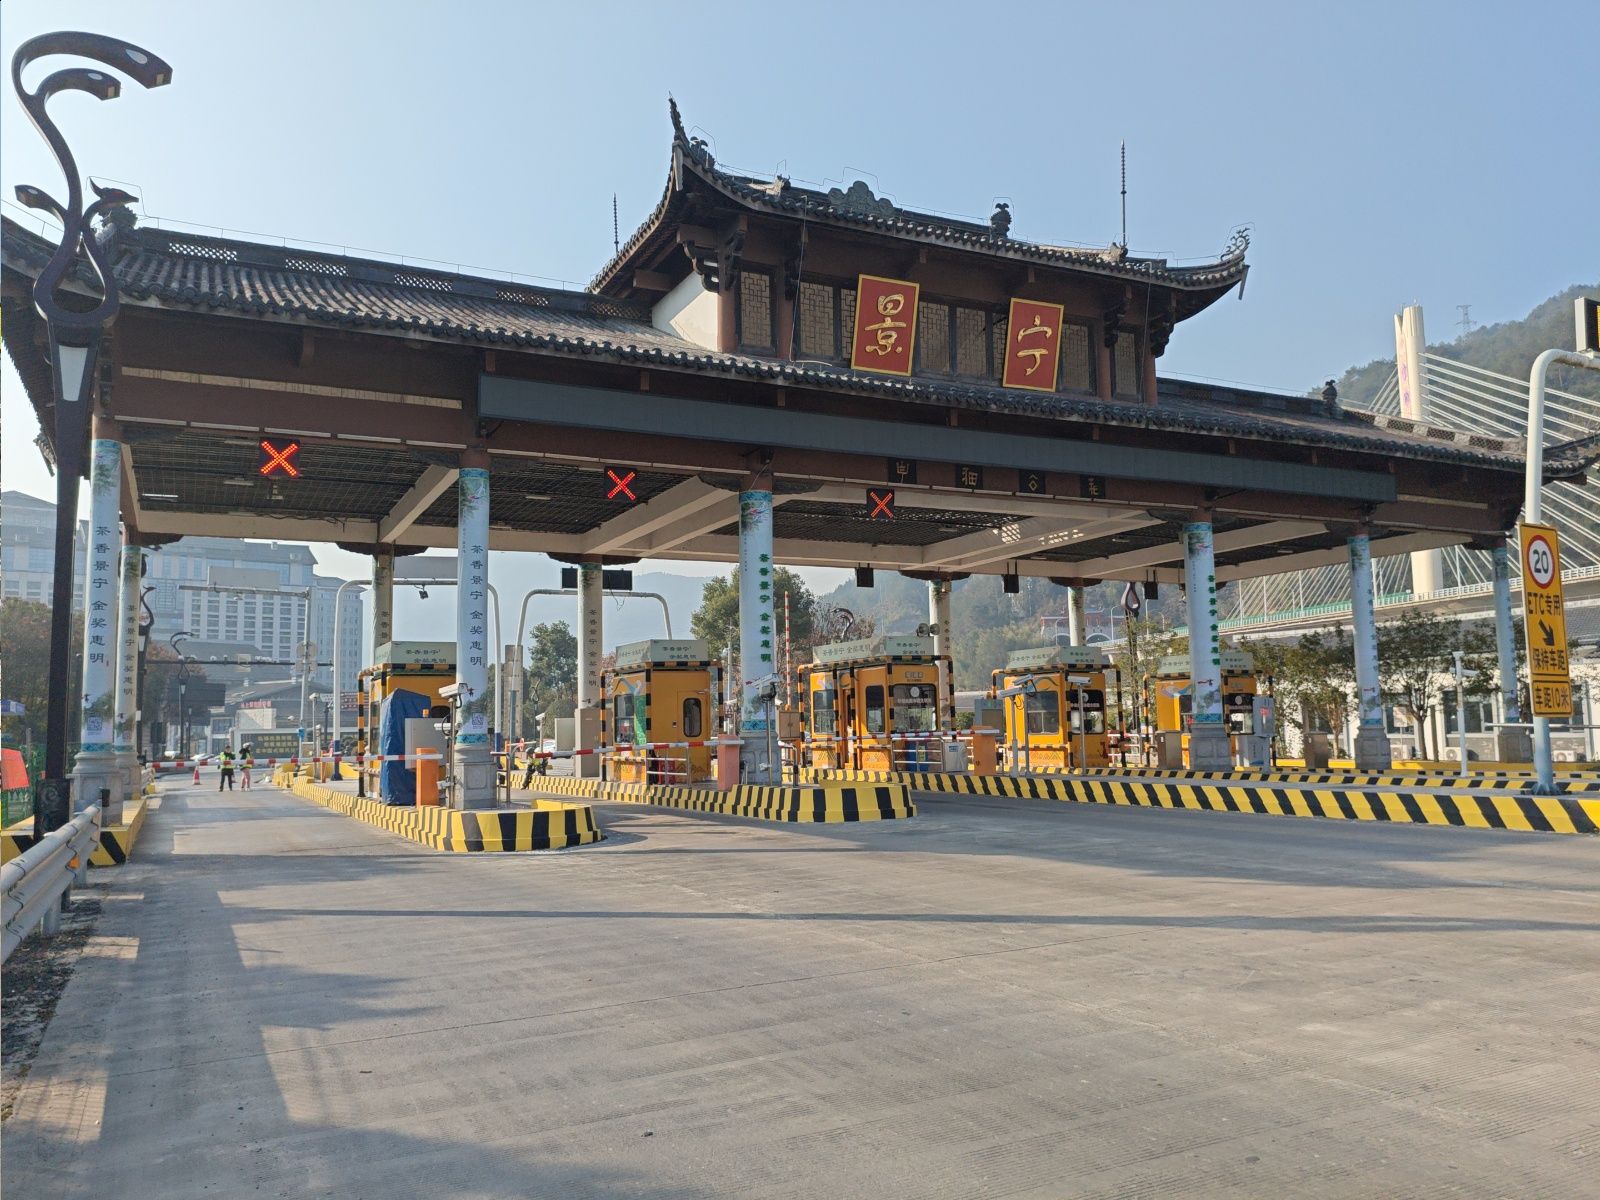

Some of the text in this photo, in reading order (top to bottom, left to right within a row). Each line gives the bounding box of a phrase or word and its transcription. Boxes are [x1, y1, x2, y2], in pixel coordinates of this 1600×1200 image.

[865, 293, 1053, 376] 景 宁
[470, 545, 483, 600] 茶香景宁
[1533, 549, 1549, 573] 20
[89, 526, 111, 664] 茶香景宁 金奖惠明
[1527, 592, 1562, 616] ETC专用
[1532, 648, 1566, 671] 保持车距
[1534, 685, 1570, 711] 车距10米
